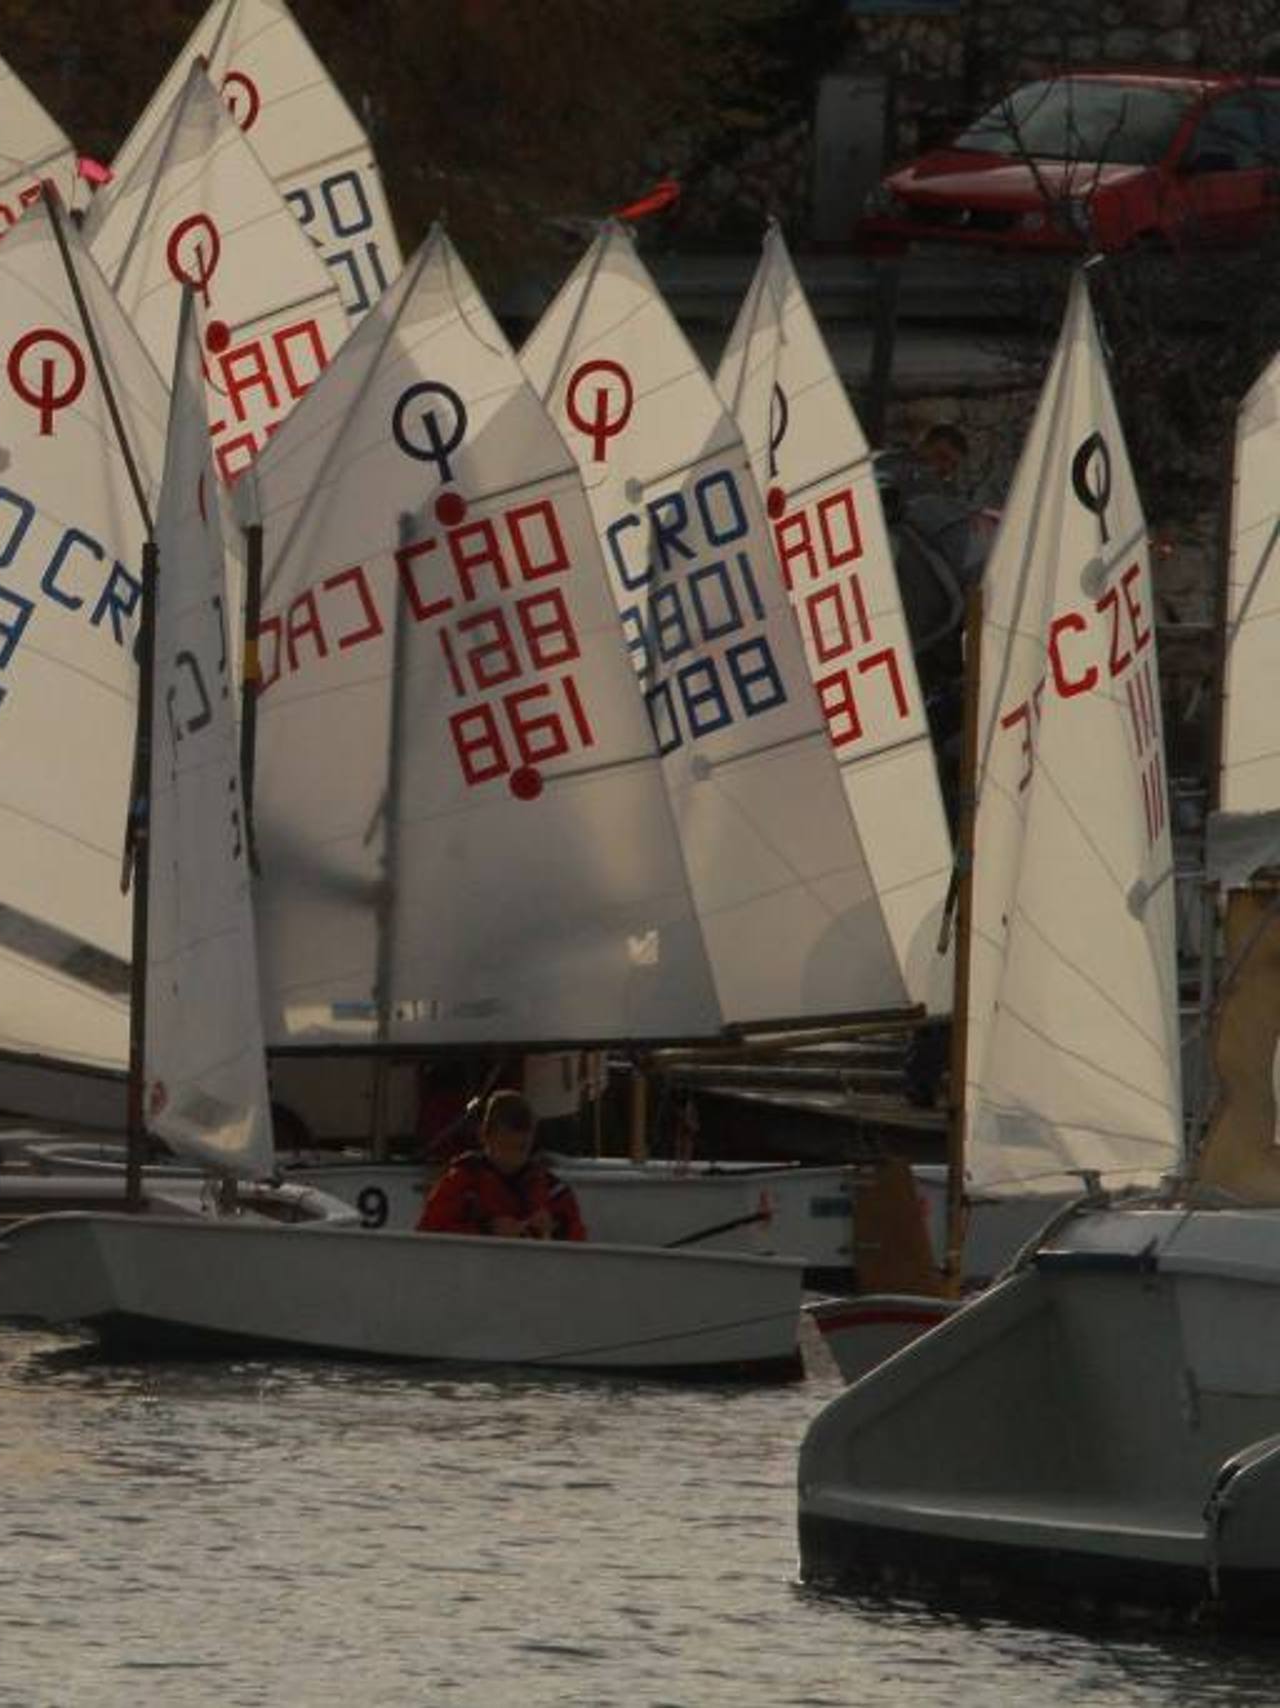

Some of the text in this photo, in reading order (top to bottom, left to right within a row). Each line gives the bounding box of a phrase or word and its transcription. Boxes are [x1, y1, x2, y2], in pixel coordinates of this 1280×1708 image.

[608, 470, 748, 581] CRO
[1048, 563, 1151, 698] CZE
[450, 676, 593, 785] 861
[358, 1187, 388, 1229] 9
